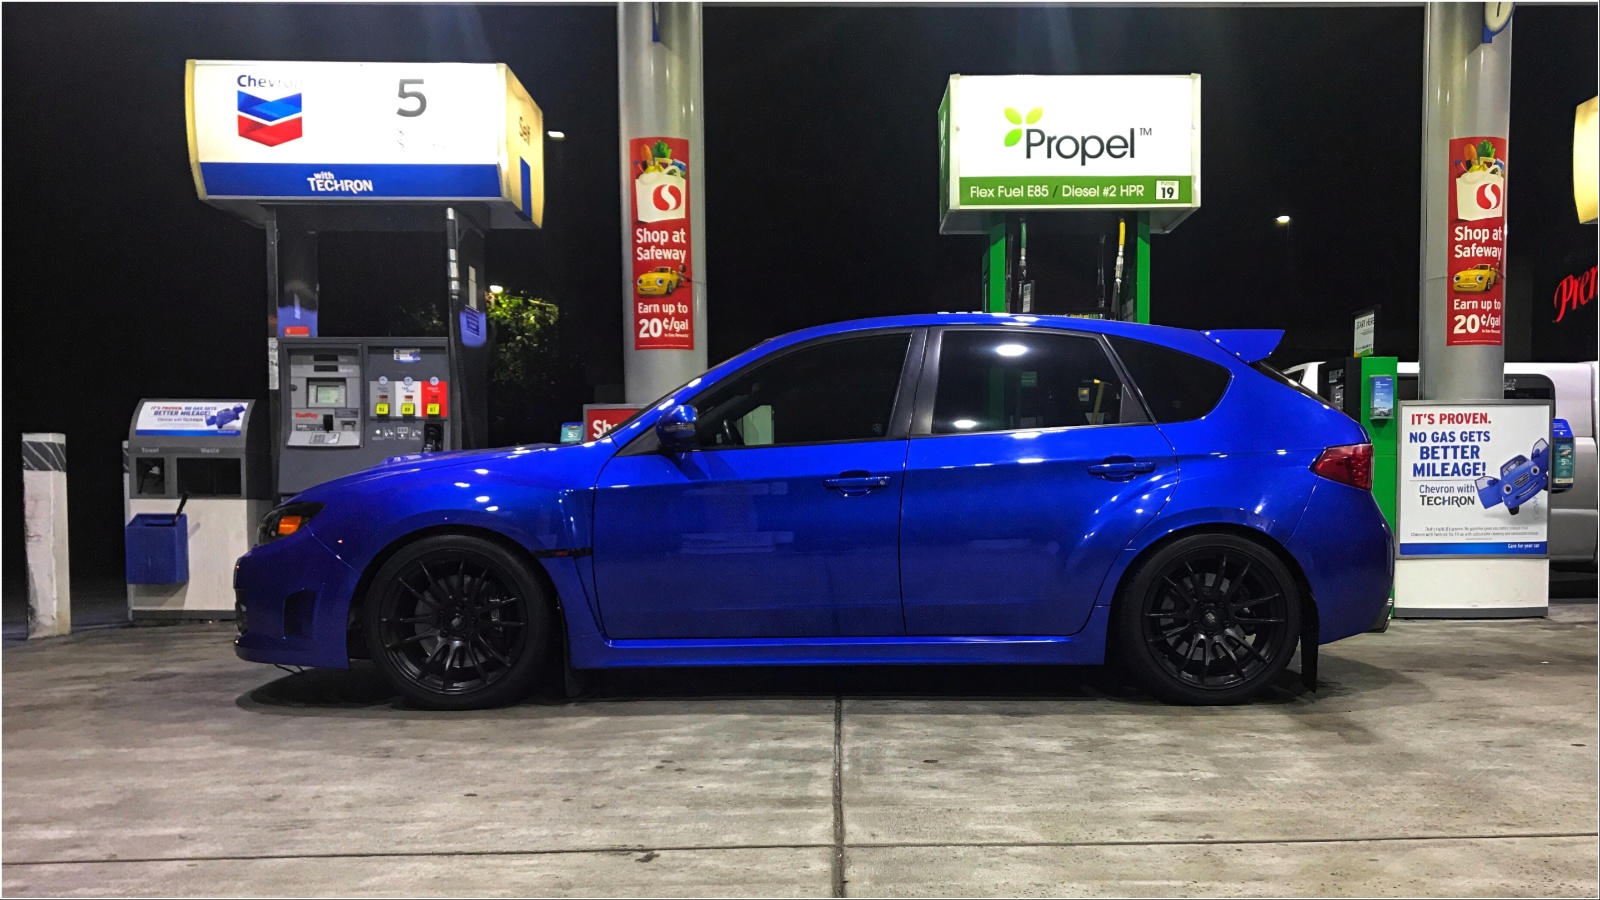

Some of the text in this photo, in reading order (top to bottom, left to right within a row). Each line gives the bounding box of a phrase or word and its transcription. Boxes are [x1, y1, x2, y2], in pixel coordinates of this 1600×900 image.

[237, 74, 302, 88] Chev
[396, 78, 427, 117] 5
[1026, 127, 1135, 166] Propel
[313, 171, 335, 180] with
[306, 177, 374, 194] TECHRON
[970, 185, 995, 198] Flex
[997, 185, 1024, 198] Fuel
[1027, 185, 1049, 197] E85
[1062, 185, 1100, 197] Diesel
[1102, 185, 1117, 197] #2
[1120, 184, 1145, 197] HPR
[1161, 187, 1175, 198] 19
[636, 227, 686, 245] Shop at
[1454, 226, 1503, 243] Shop at
[636, 245, 687, 264] Safeway
[1454, 243, 1502, 261] Safeway
[638, 301, 688, 315] Earn up to
[1453, 298, 1501, 311] Earn up to
[1411, 412, 1492, 425] IT'S PROVEN.
[592, 419, 618, 439] Sh
[1409, 430, 1491, 443] NO GAS GETS
[1419, 444, 1481, 460] BETTER
[1412, 461, 1486, 477] MILEAGE!
[1419, 483, 1475, 494] Chevron with
[1419, 494, 1475, 508] TECHRON
